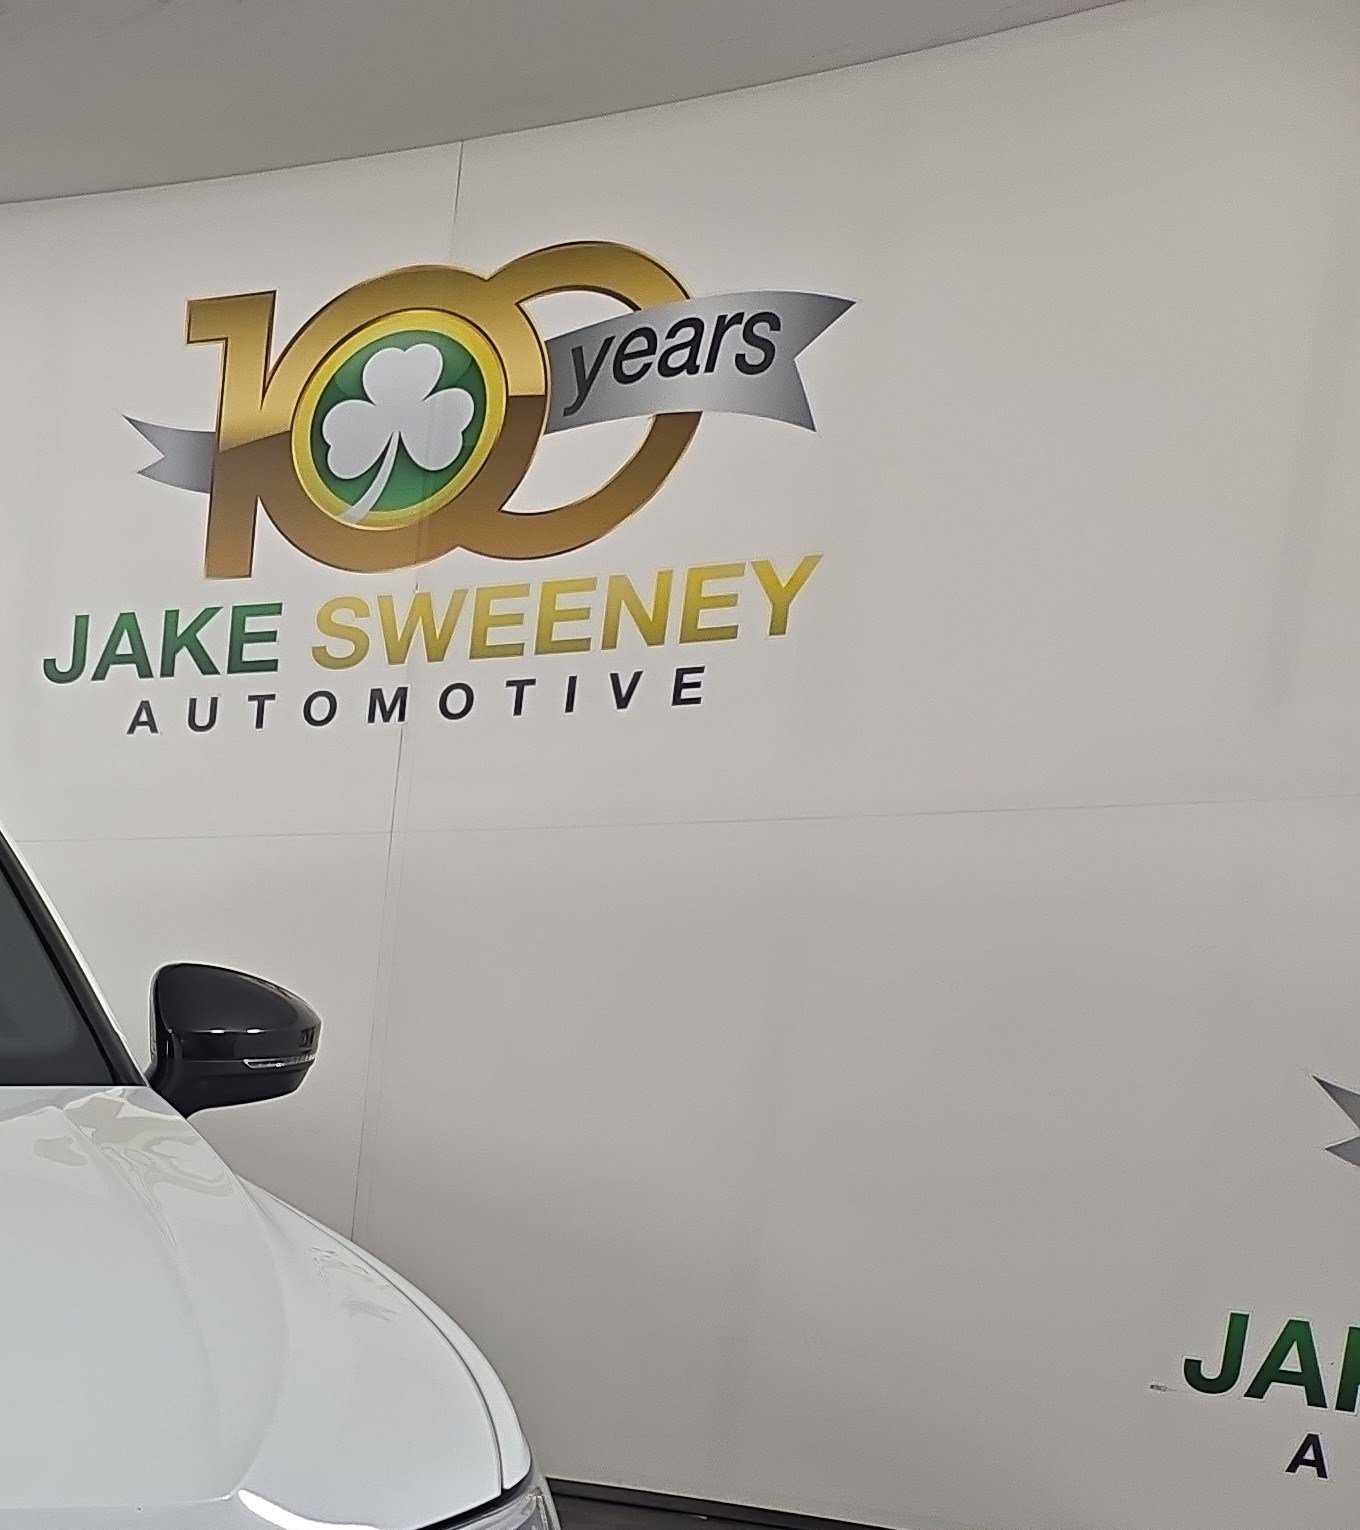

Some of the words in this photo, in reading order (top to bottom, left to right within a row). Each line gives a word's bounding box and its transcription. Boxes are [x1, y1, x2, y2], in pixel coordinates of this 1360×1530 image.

[562, 309, 782, 417] years
[43, 602, 282, 685] JAKE
[311, 555, 824, 670] SWEENEY
[127, 666, 707, 736] AUTOMOTIVE
[1183, 1311, 1360, 1414] JA
